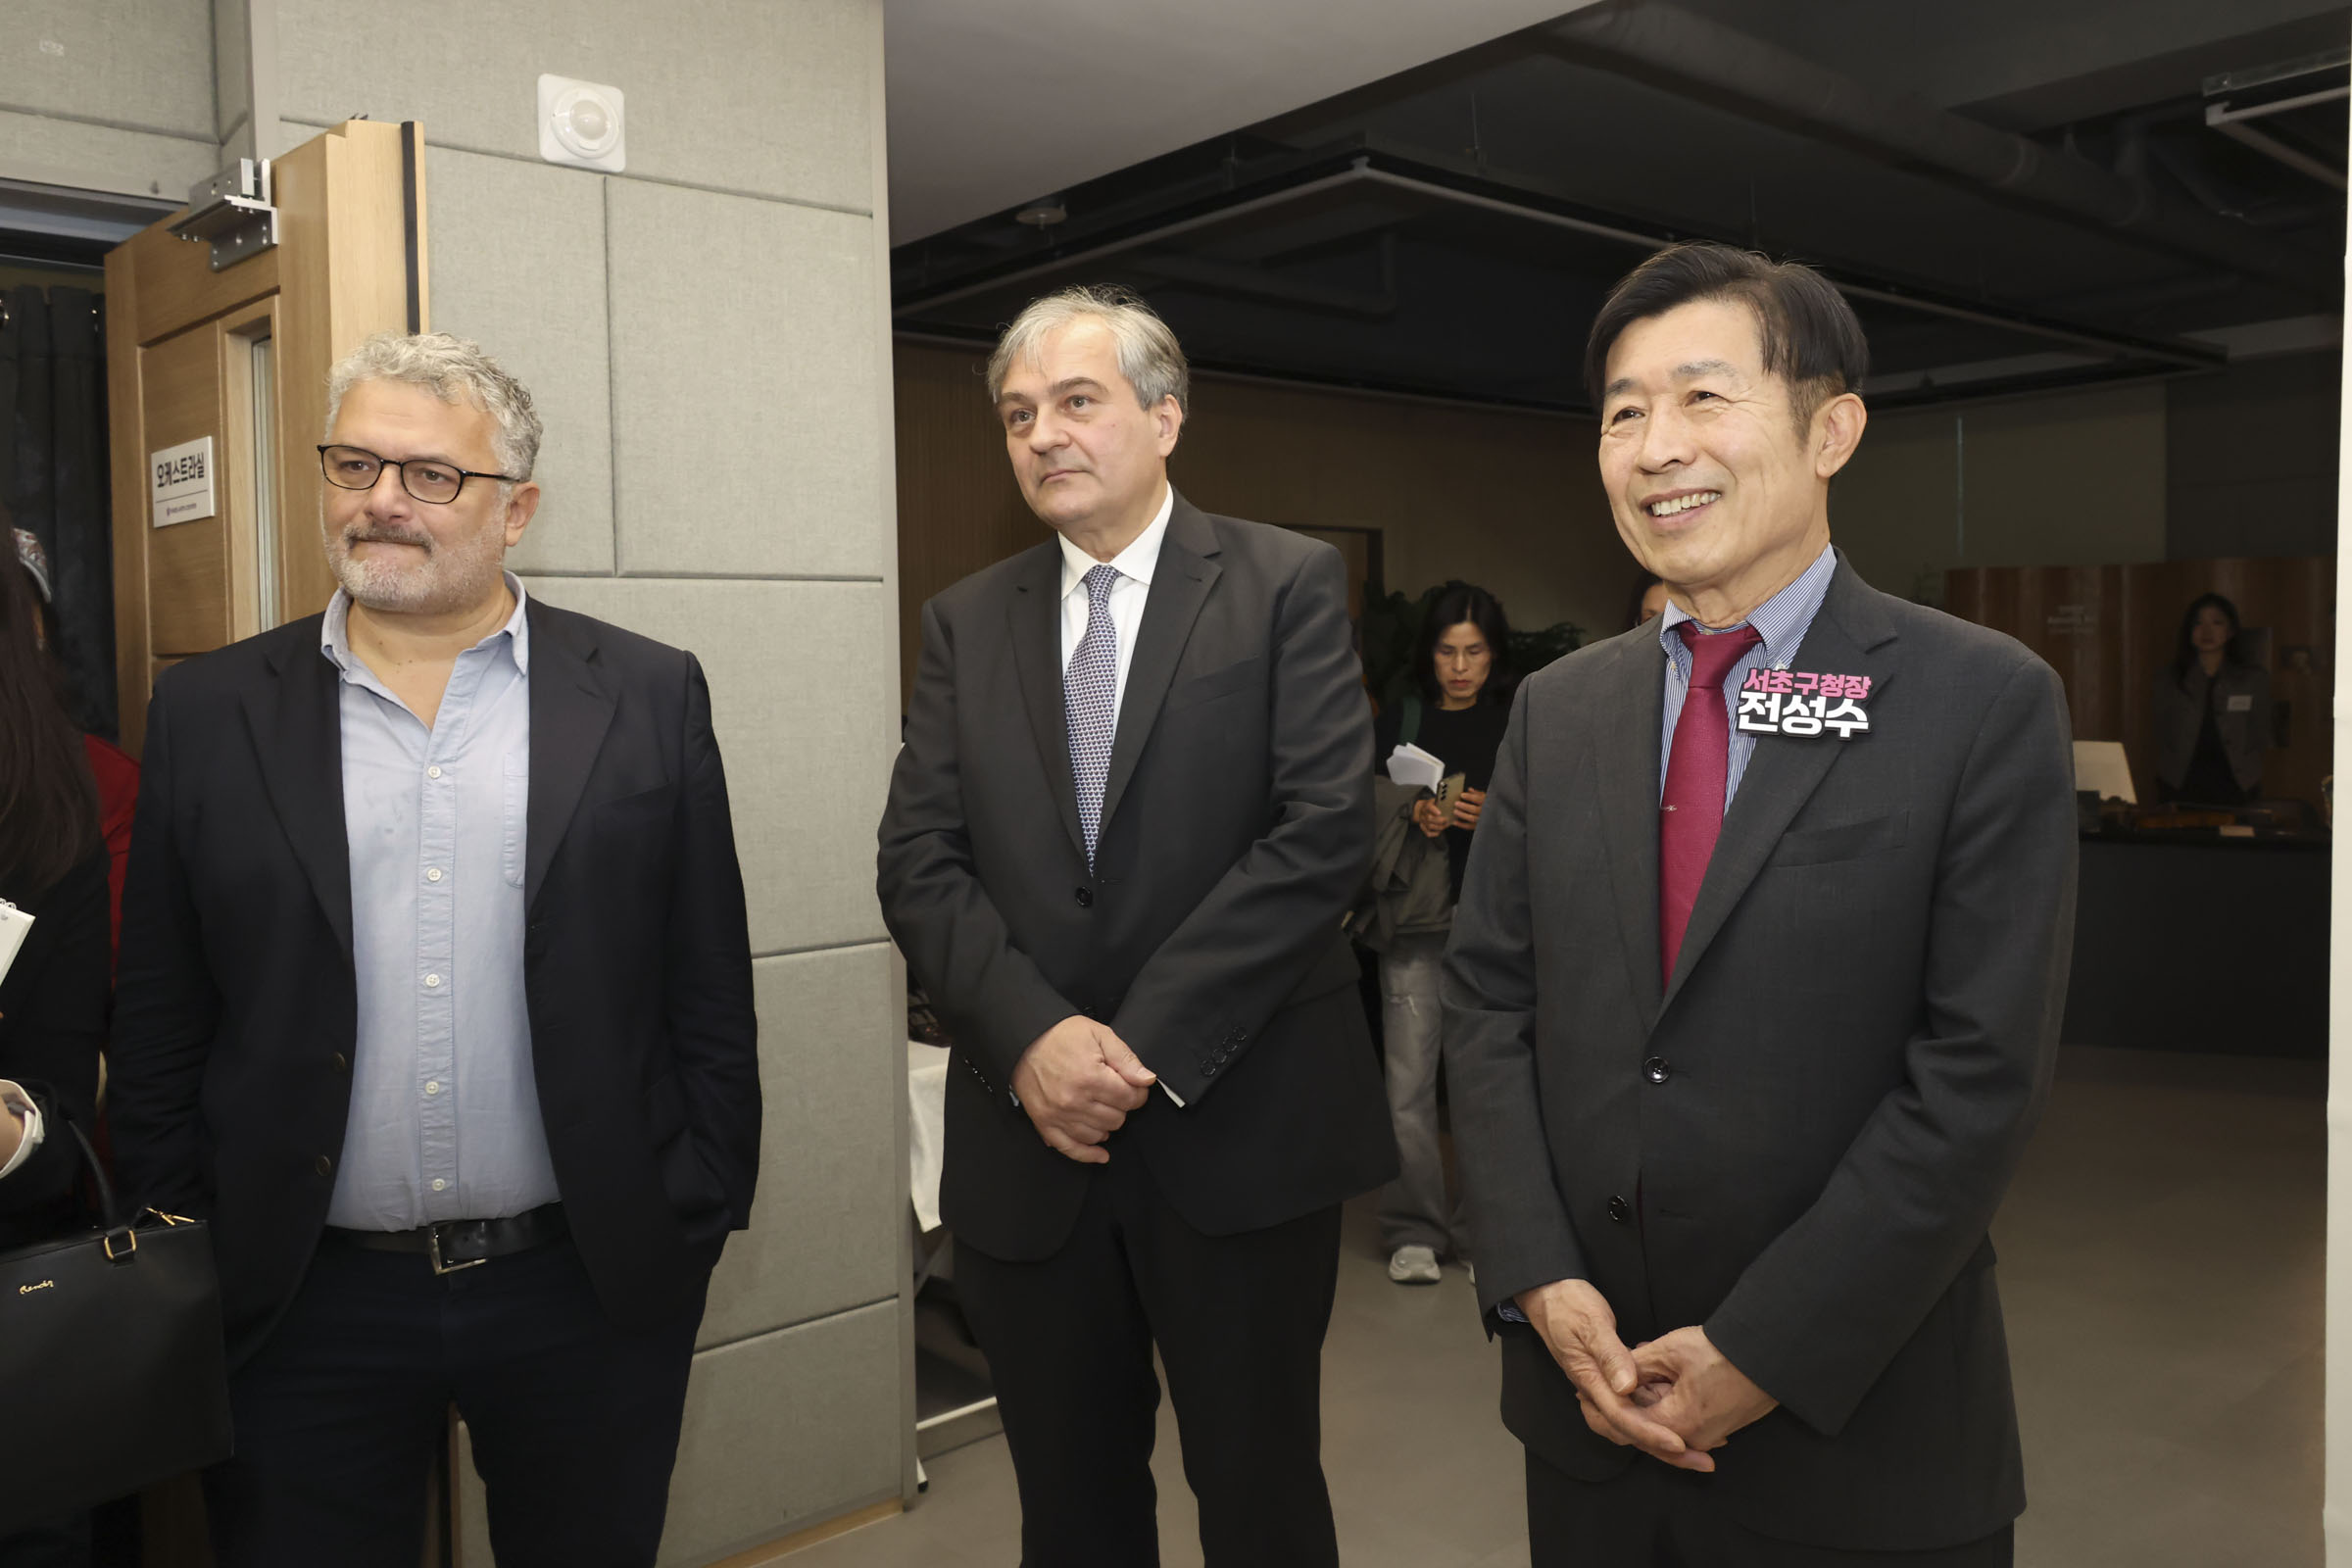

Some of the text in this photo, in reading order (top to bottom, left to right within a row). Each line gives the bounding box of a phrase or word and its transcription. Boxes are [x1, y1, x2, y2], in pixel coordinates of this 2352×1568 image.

[157, 452, 205, 488] 오케스트라실
[1743, 668, 1872, 700] 서초구청장
[1738, 691, 1870, 738] 전성수
